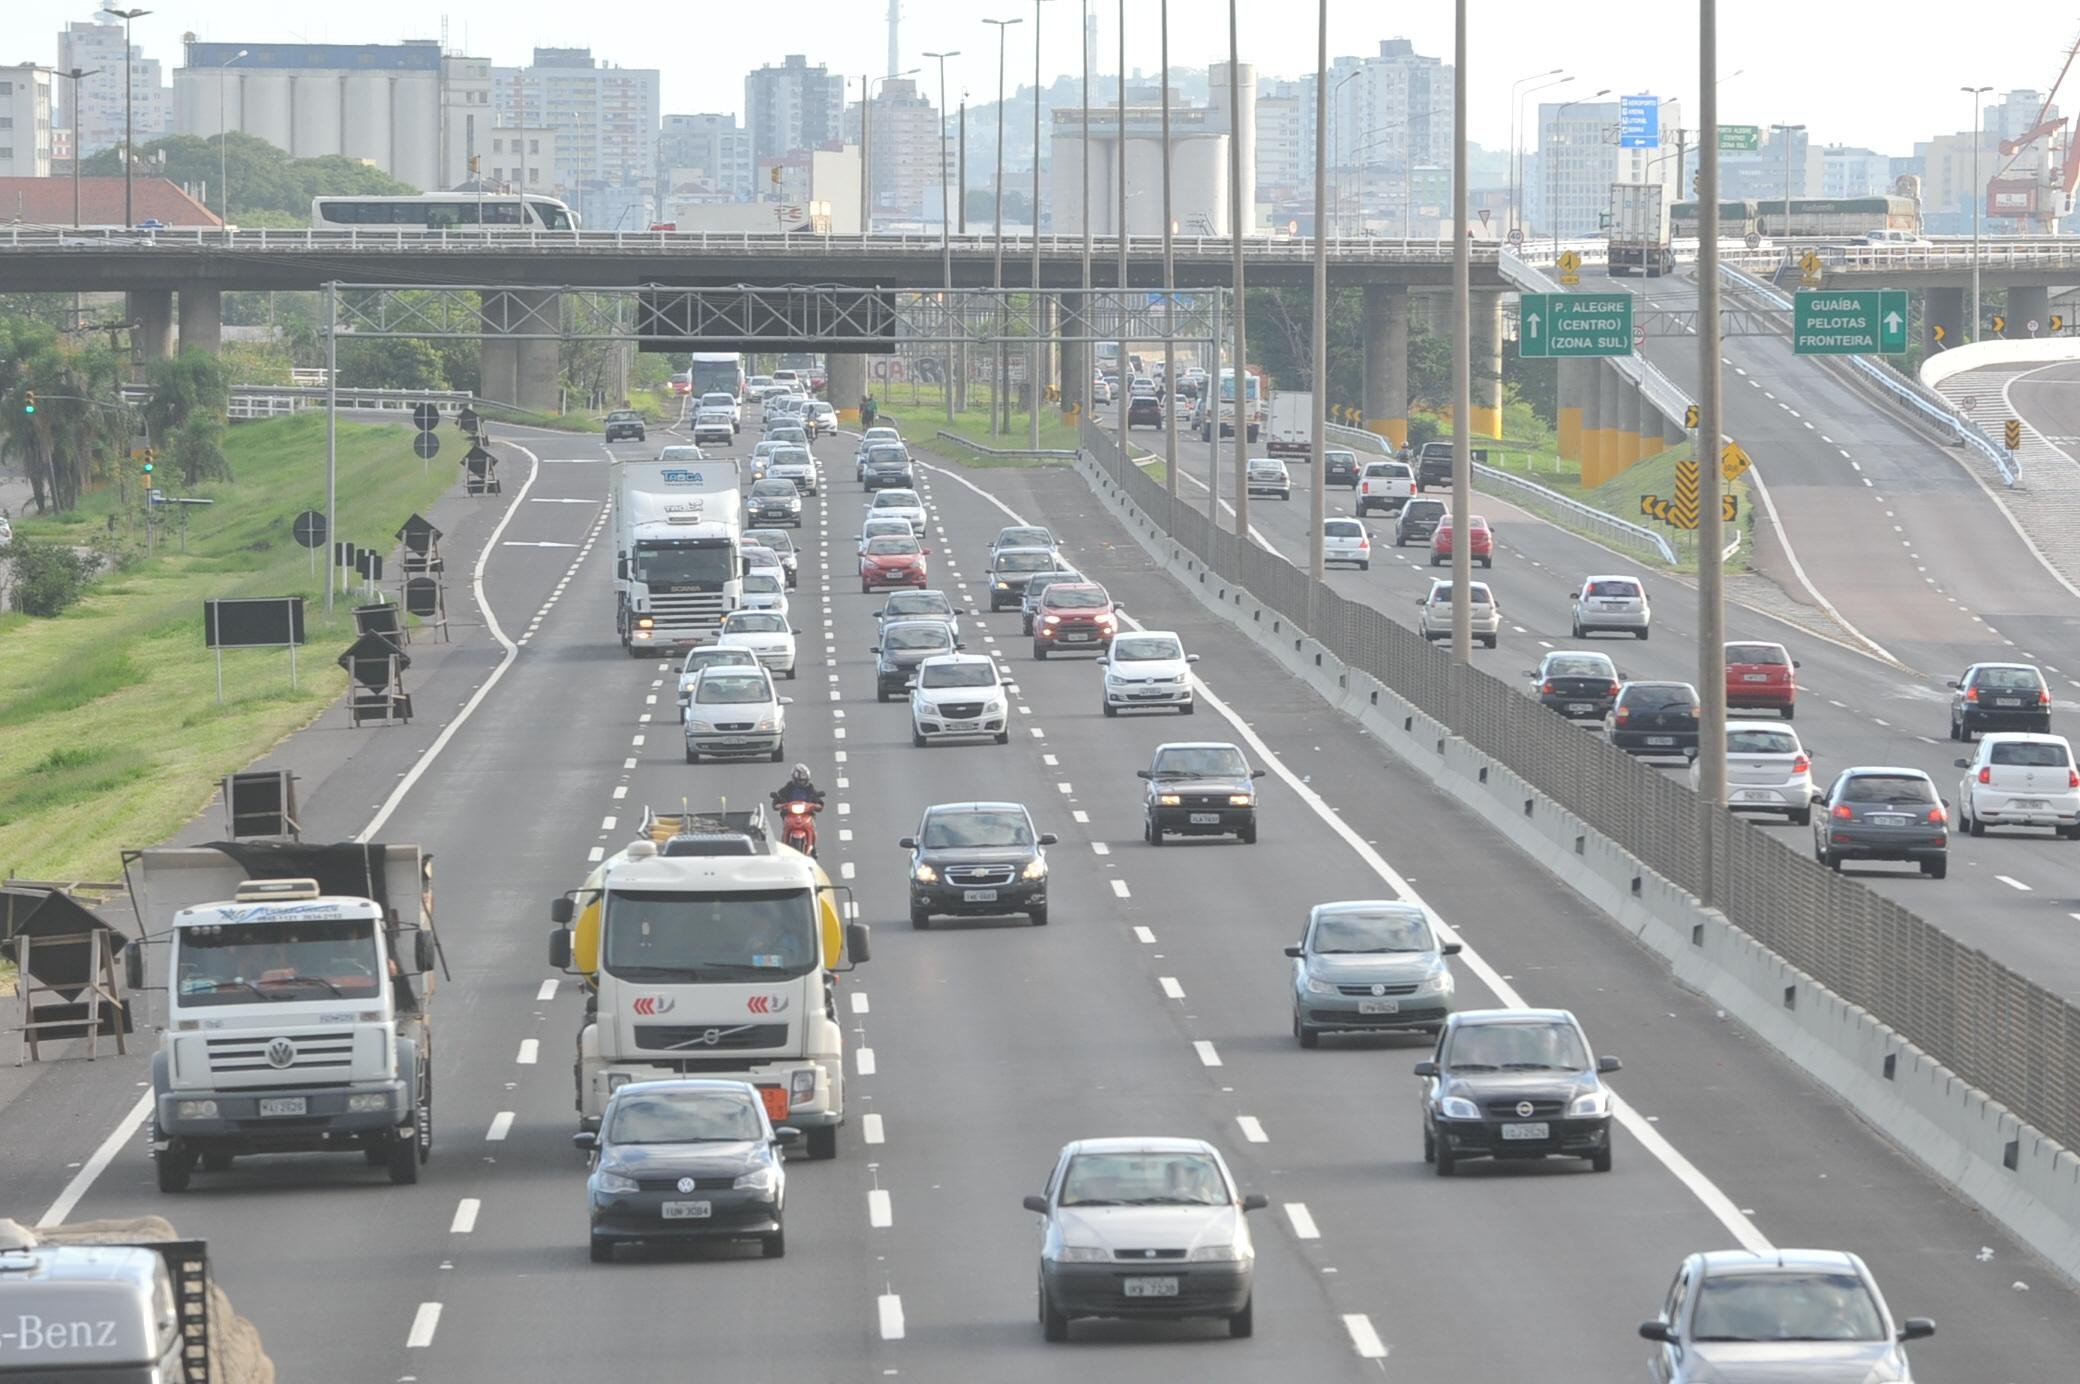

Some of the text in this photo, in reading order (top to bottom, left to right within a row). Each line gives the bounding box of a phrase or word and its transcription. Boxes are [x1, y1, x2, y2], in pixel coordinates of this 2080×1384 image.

[1510, 232, 1521, 240] 40
[1555, 302, 1625, 313] P. ALEGRE
[1811, 297, 1861, 311] GUAÍBA
[1558, 318, 1622, 331] (CENTRO)
[1807, 317, 1866, 329] PELOTAS
[1551, 336, 1628, 349] (ZONA SUL)
[1799, 335, 1873, 346] FRONTEIRA
[0, 1314, 118, 1350] -Benz
